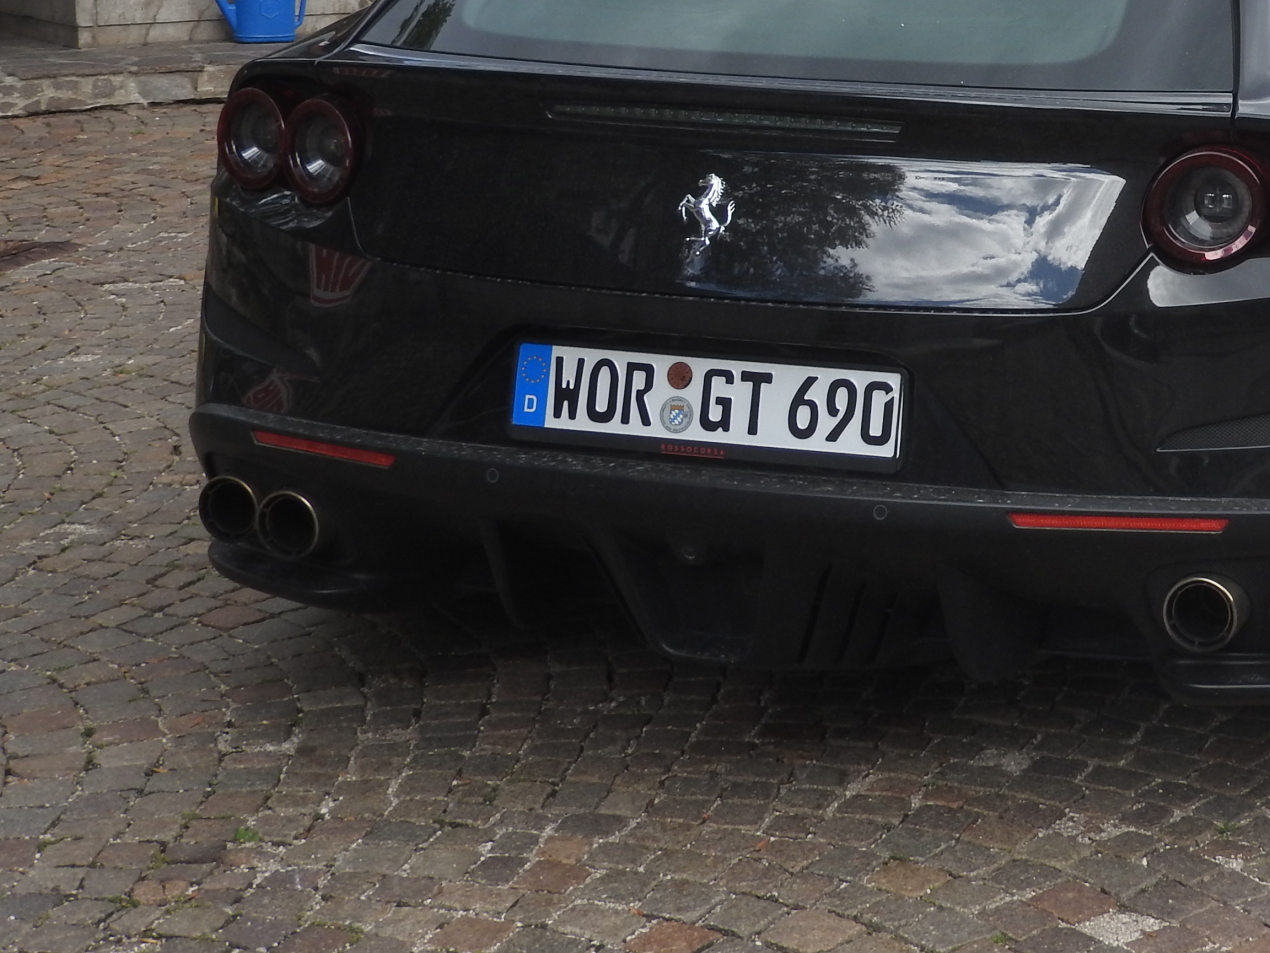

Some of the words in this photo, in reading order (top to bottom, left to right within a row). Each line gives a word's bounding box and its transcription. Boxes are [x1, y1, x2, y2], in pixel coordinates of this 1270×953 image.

[523, 394, 537, 412] D
[553, 356, 655, 426] WOR
[700, 368, 774, 435] GT
[788, 376, 895, 446] 690
[661, 443, 725, 455] ROSSOCORSA
